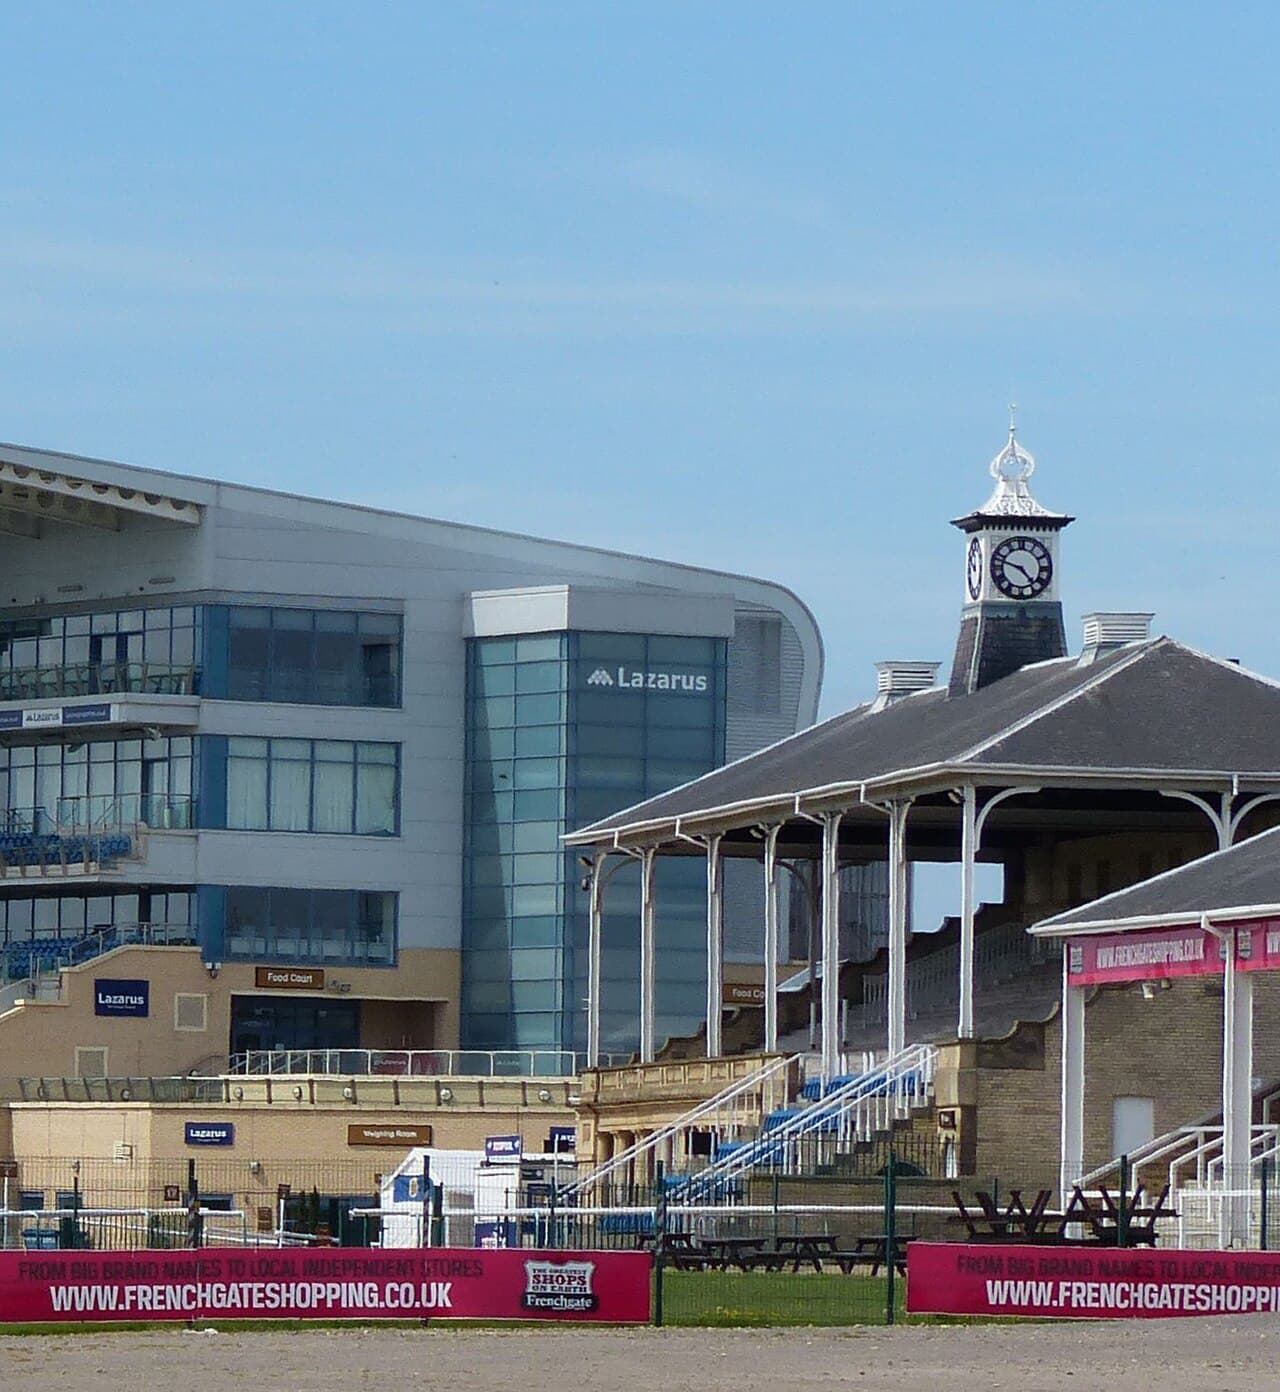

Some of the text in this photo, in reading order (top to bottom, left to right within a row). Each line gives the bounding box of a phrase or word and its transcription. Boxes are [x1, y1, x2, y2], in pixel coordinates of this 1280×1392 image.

[618, 667, 707, 691] Lazarus
[268, 972, 313, 984] Food Court
[98, 992, 144, 1005] Lazarus
[190, 1129, 227, 1138] Lazarus
[362, 1129, 418, 1140] Weighing Room
[19, 1258, 483, 1281] FROM BIG BRAND NAMES TO LOCAL INDEPENDENT STORES
[957, 1255, 1004, 1275] FROM
[1008, 1256, 1036, 1276] BIG
[1040, 1257, 1093, 1277] BRAND
[1098, 1258, 1155, 1279] NAMES
[1160, 1260, 1180, 1279] TO
[1182, 1260, 1229, 1281] LOCAL
[532, 1274, 586, 1285] SHOPS
[50, 1282, 452, 1312] WWW.FRENCHGATESHOPPING.CO.UK
[526, 1295, 592, 1309] Frenchgate
[986, 1280, 1280, 1312] WWW.FRENCHGATESHOPPI
